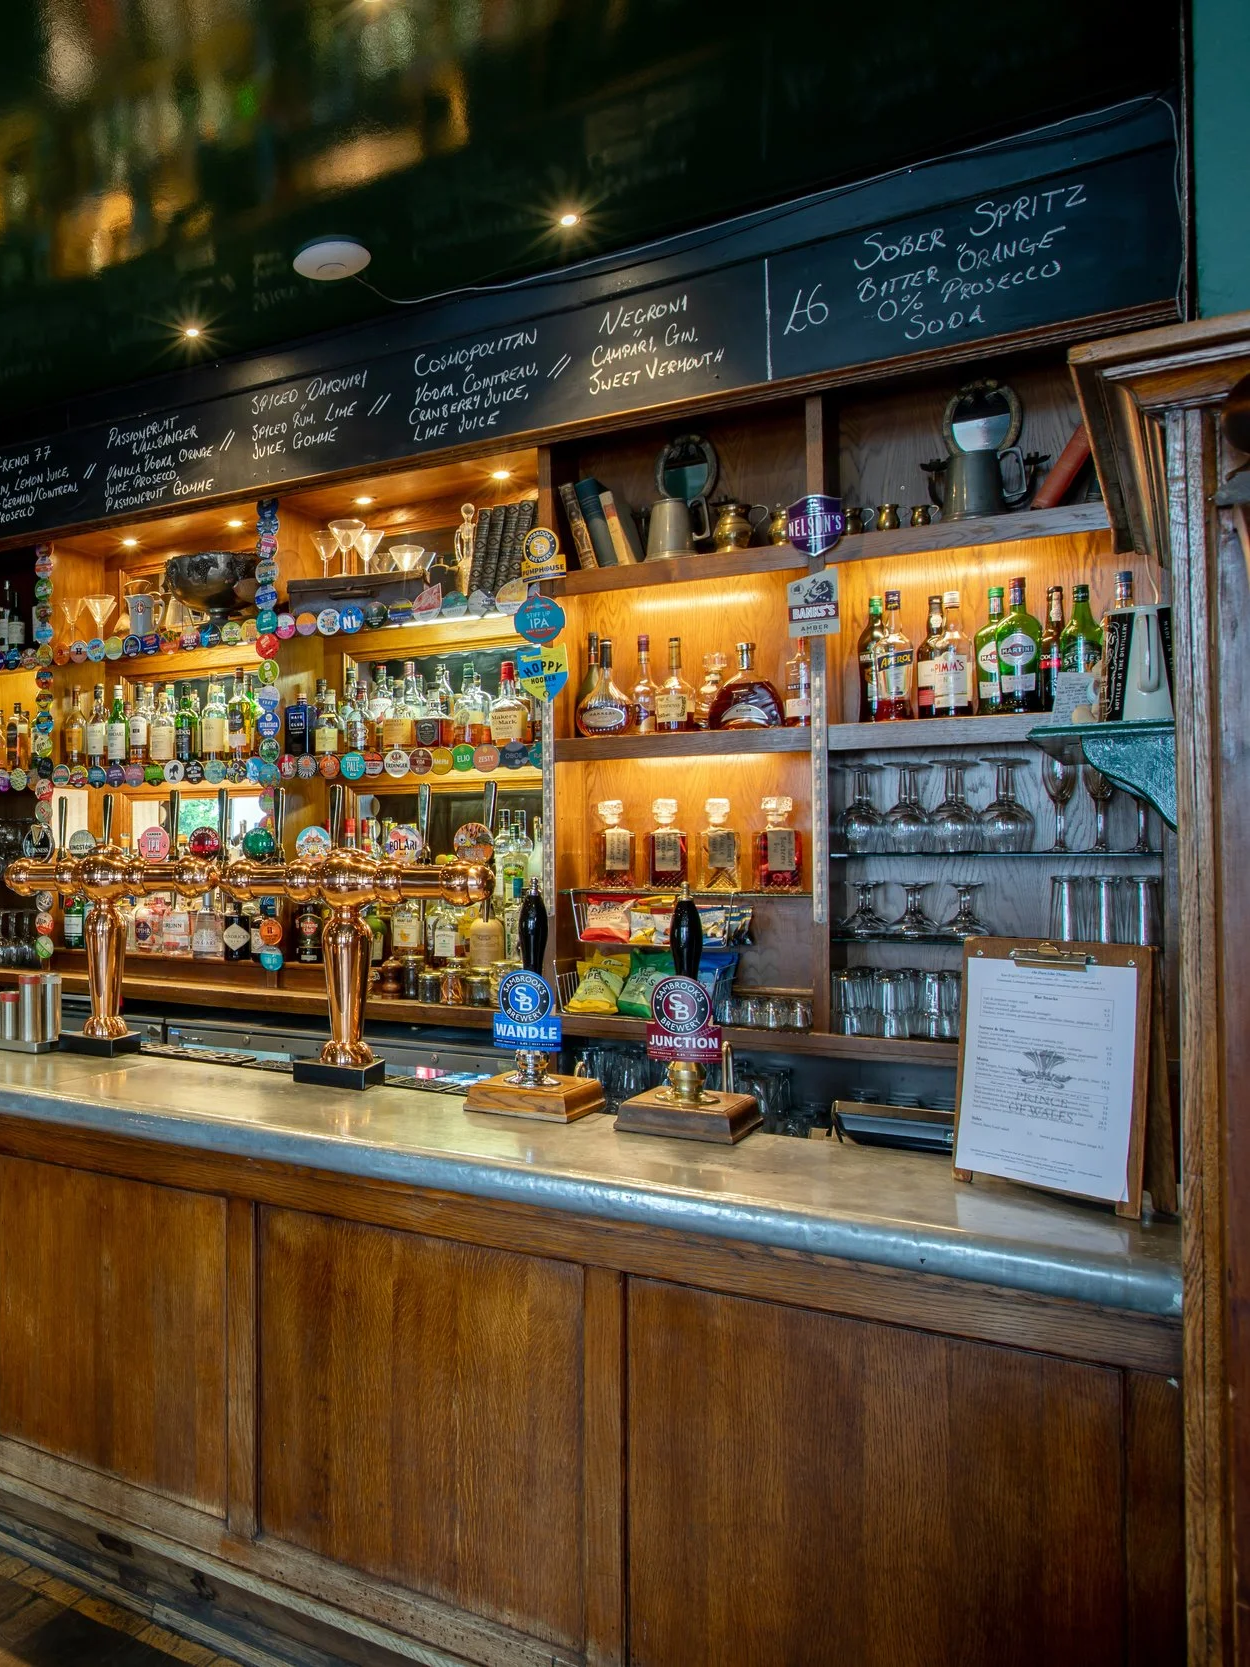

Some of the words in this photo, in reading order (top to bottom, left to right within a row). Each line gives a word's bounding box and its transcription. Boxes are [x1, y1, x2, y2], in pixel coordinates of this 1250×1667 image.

[854, 228, 946, 270] SOBER
[970, 184, 1087, 237] SPRITZ
[858, 266, 940, 302] BITTER
[958, 226, 1066, 272] ORANGE
[877, 291, 923, 321] 0%
[941, 260, 1061, 302] PROSECCO
[599, 295, 688, 334] NEGRONI
[905, 305, 985, 340] SODA
[415, 328, 537, 376] COSMOPOLITAN
[590, 368, 641, 394] SWEET
[646, 348, 724, 379] VERMOUTH
[252, 389, 298, 414] SPICED
[306, 370, 367, 400] DAIQUIRI
[409, 395, 480, 424] CRANBERRY
[252, 423, 287, 441] SPICED
[325, 401, 357, 421] LIME
[414, 422, 448, 441] LIME
[459, 410, 500, 433] JUICE
[107, 416, 179, 448] PASSIONFRUIT
[293, 427, 338, 449] GOMME
[15, 474, 43, 491] LEMON
[173, 479, 214, 496] GOMME
[788, 515, 841, 536] NELSON'S
[530, 618, 549, 629] IPA
[1001, 645, 1034, 654] MARTINI
[523, 660, 563, 677] HOPPY
[880, 654, 911, 669] APEROL
[935, 660, 964, 672] PIMM'S
[531, 675, 556, 684] HOOKER
[478, 755, 494, 763] ZESTY
[389, 839, 418, 850] POLARI
[503, 976, 546, 995] SAMBROOK'S
[656, 982, 704, 1002] SAMBROOK'S
[507, 1008, 542, 1022] BREWERY
[661, 1017, 701, 1031] BREWERY
[496, 1023, 557, 1039] WANDLE
[650, 1035, 718, 1048] JUNCTION
